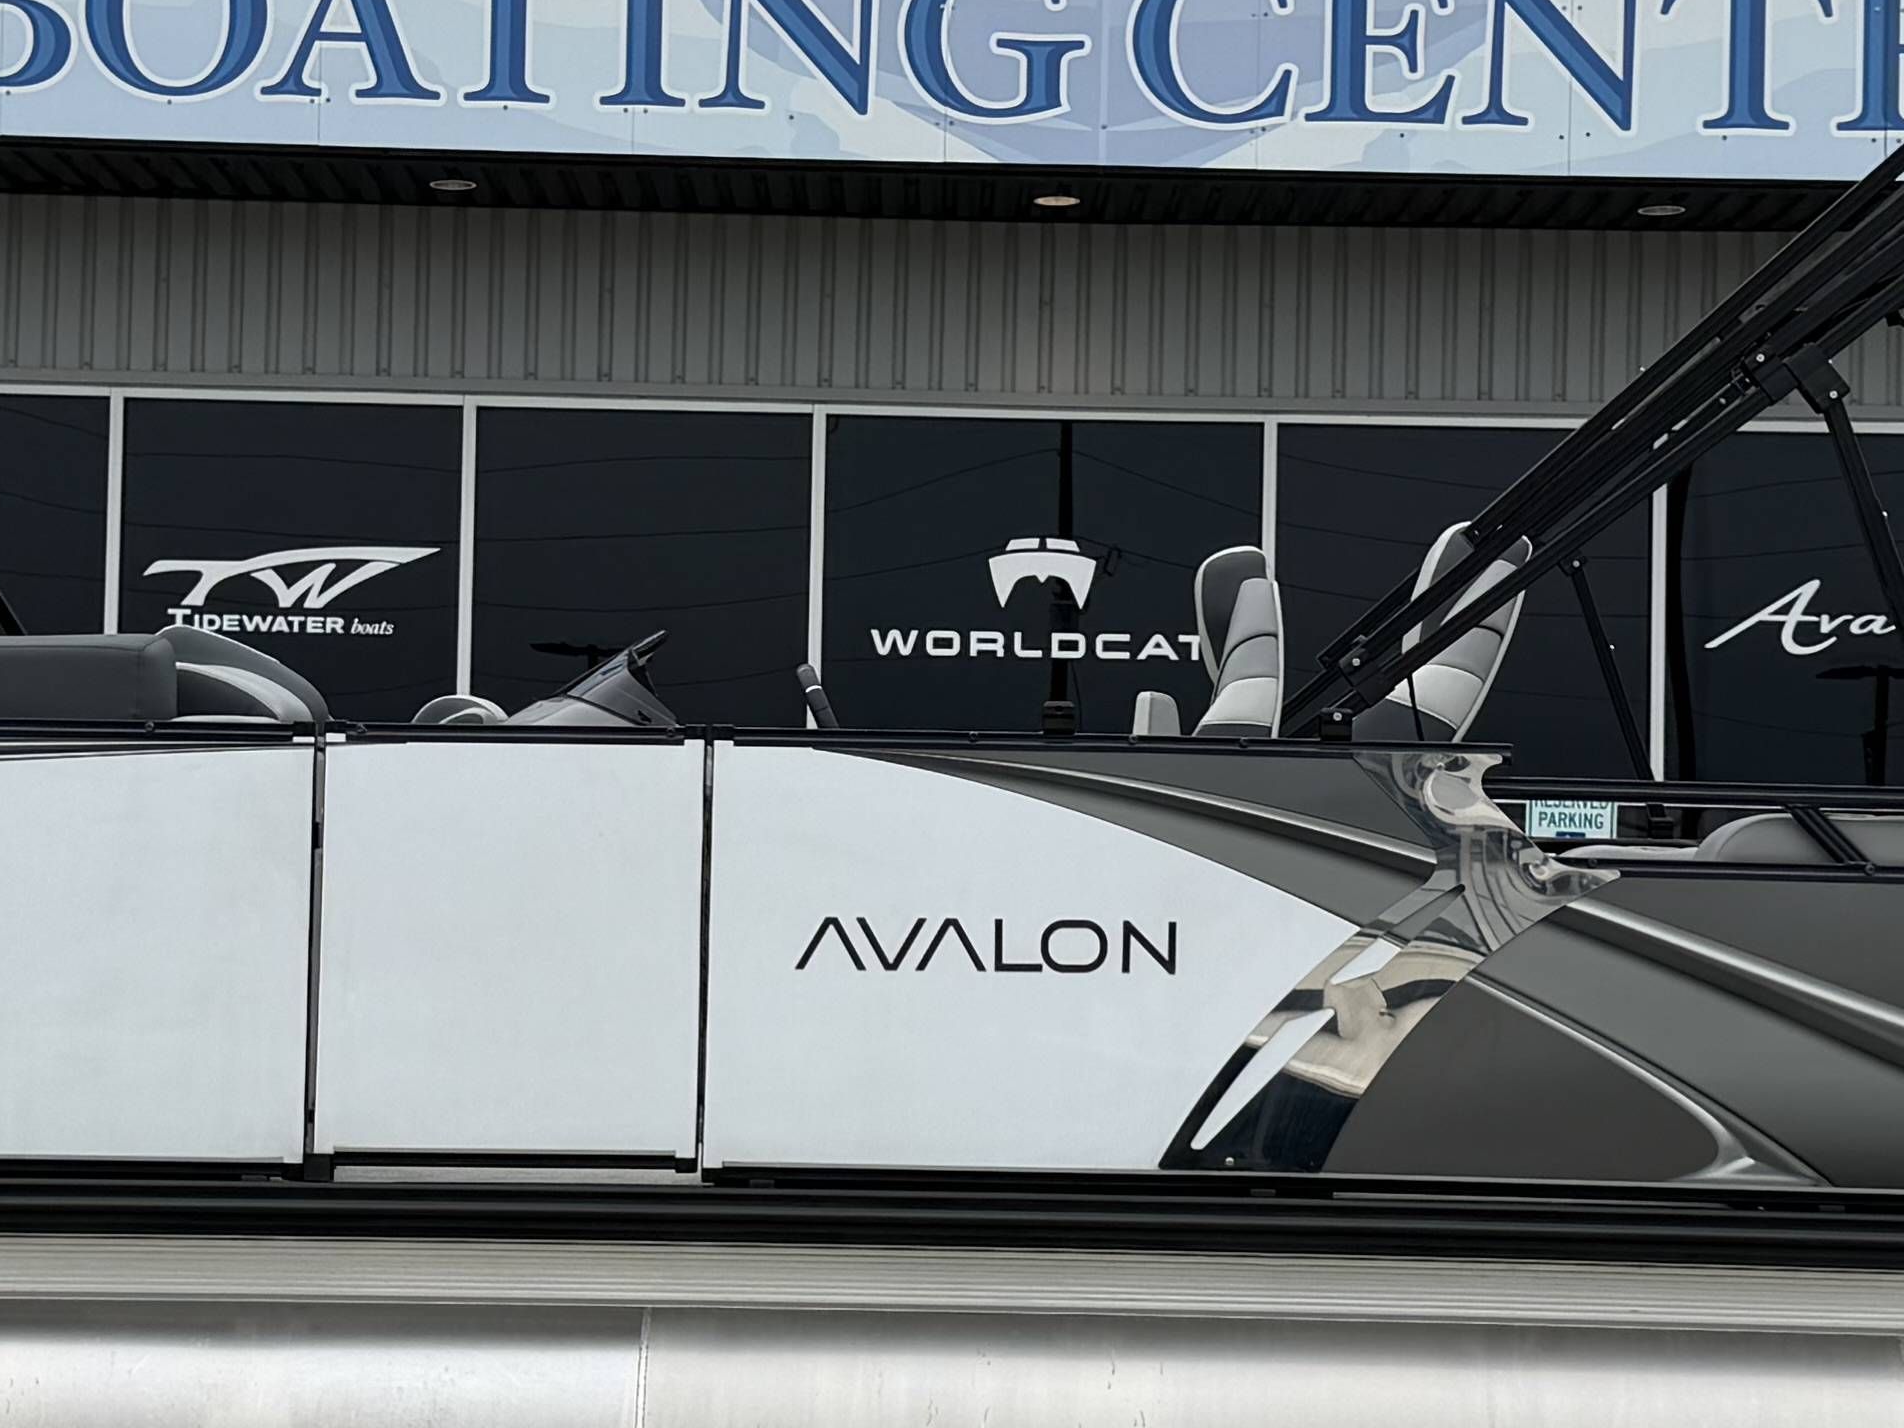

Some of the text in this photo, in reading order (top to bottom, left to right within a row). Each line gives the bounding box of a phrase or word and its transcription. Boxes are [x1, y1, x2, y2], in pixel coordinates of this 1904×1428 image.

[167, 608, 395, 636] TIDEWATER boats
[1538, 812, 1604, 829] PARKING
[795, 916, 1177, 975] AVALON
